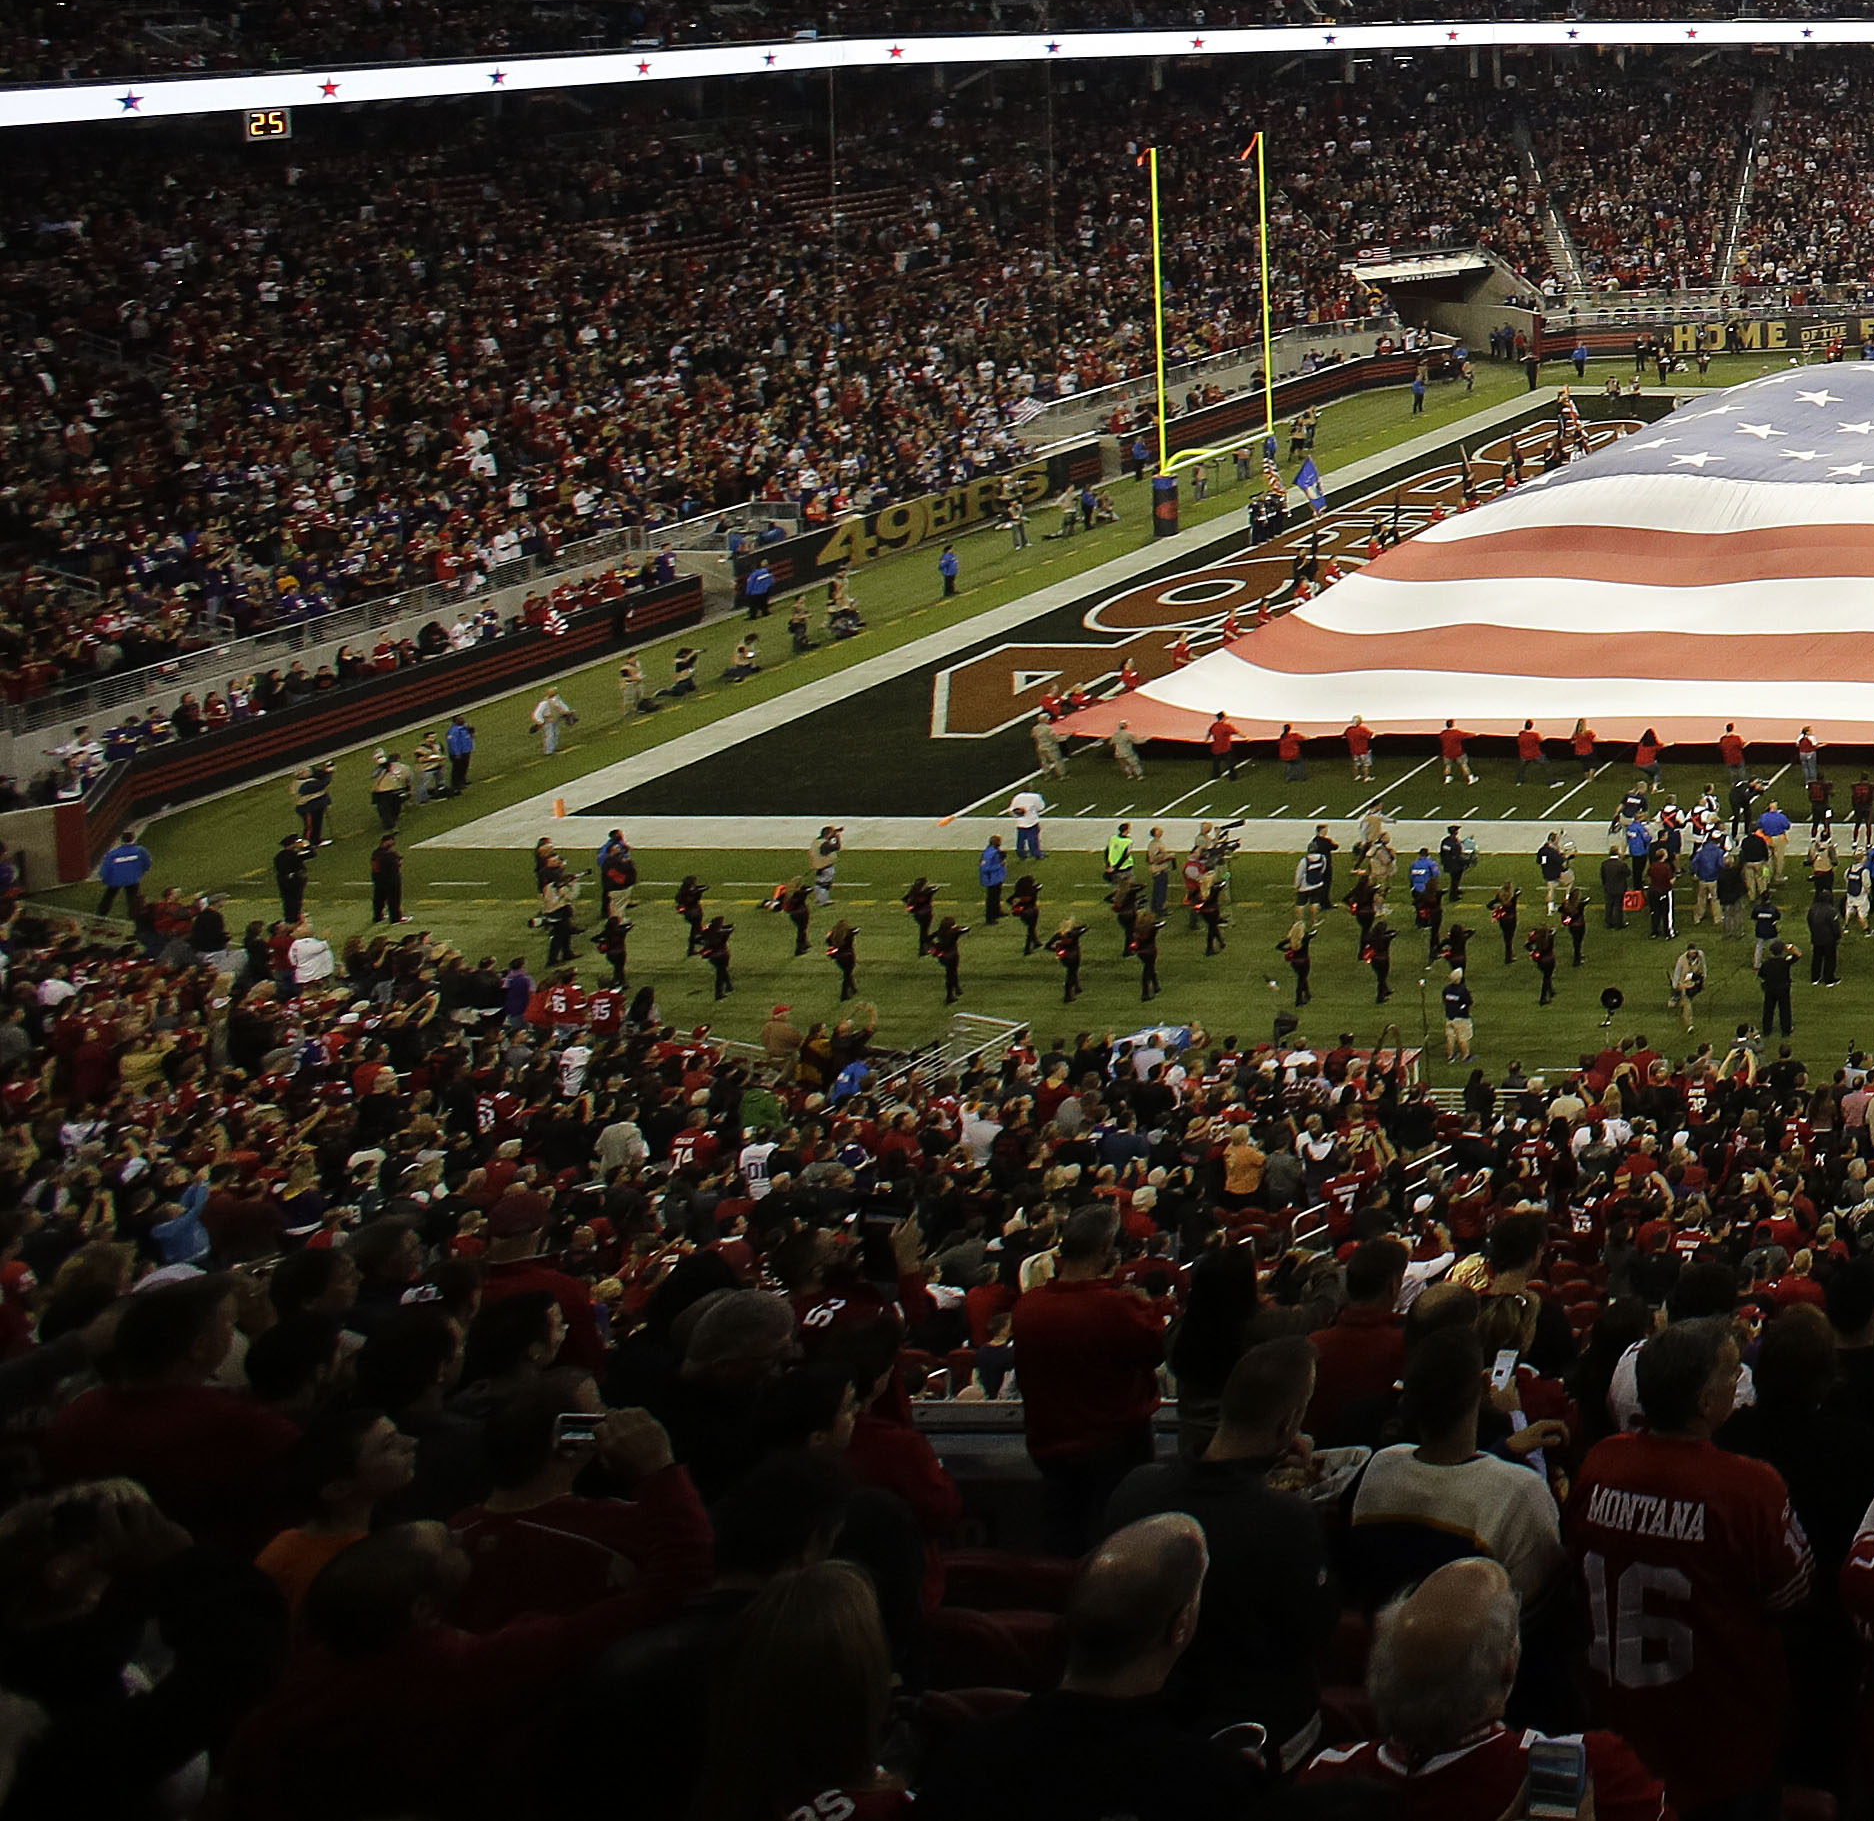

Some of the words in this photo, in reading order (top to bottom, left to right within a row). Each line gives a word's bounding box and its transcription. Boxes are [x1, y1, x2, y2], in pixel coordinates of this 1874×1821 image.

[251, 112, 283, 136] 25
[1800, 330, 1820, 343] OF
[1822, 325, 1848, 340] THE
[670, 1147, 695, 1174] 74
[1586, 1485, 1706, 1542] MONTANA
[1583, 1547, 1695, 1690] 16
